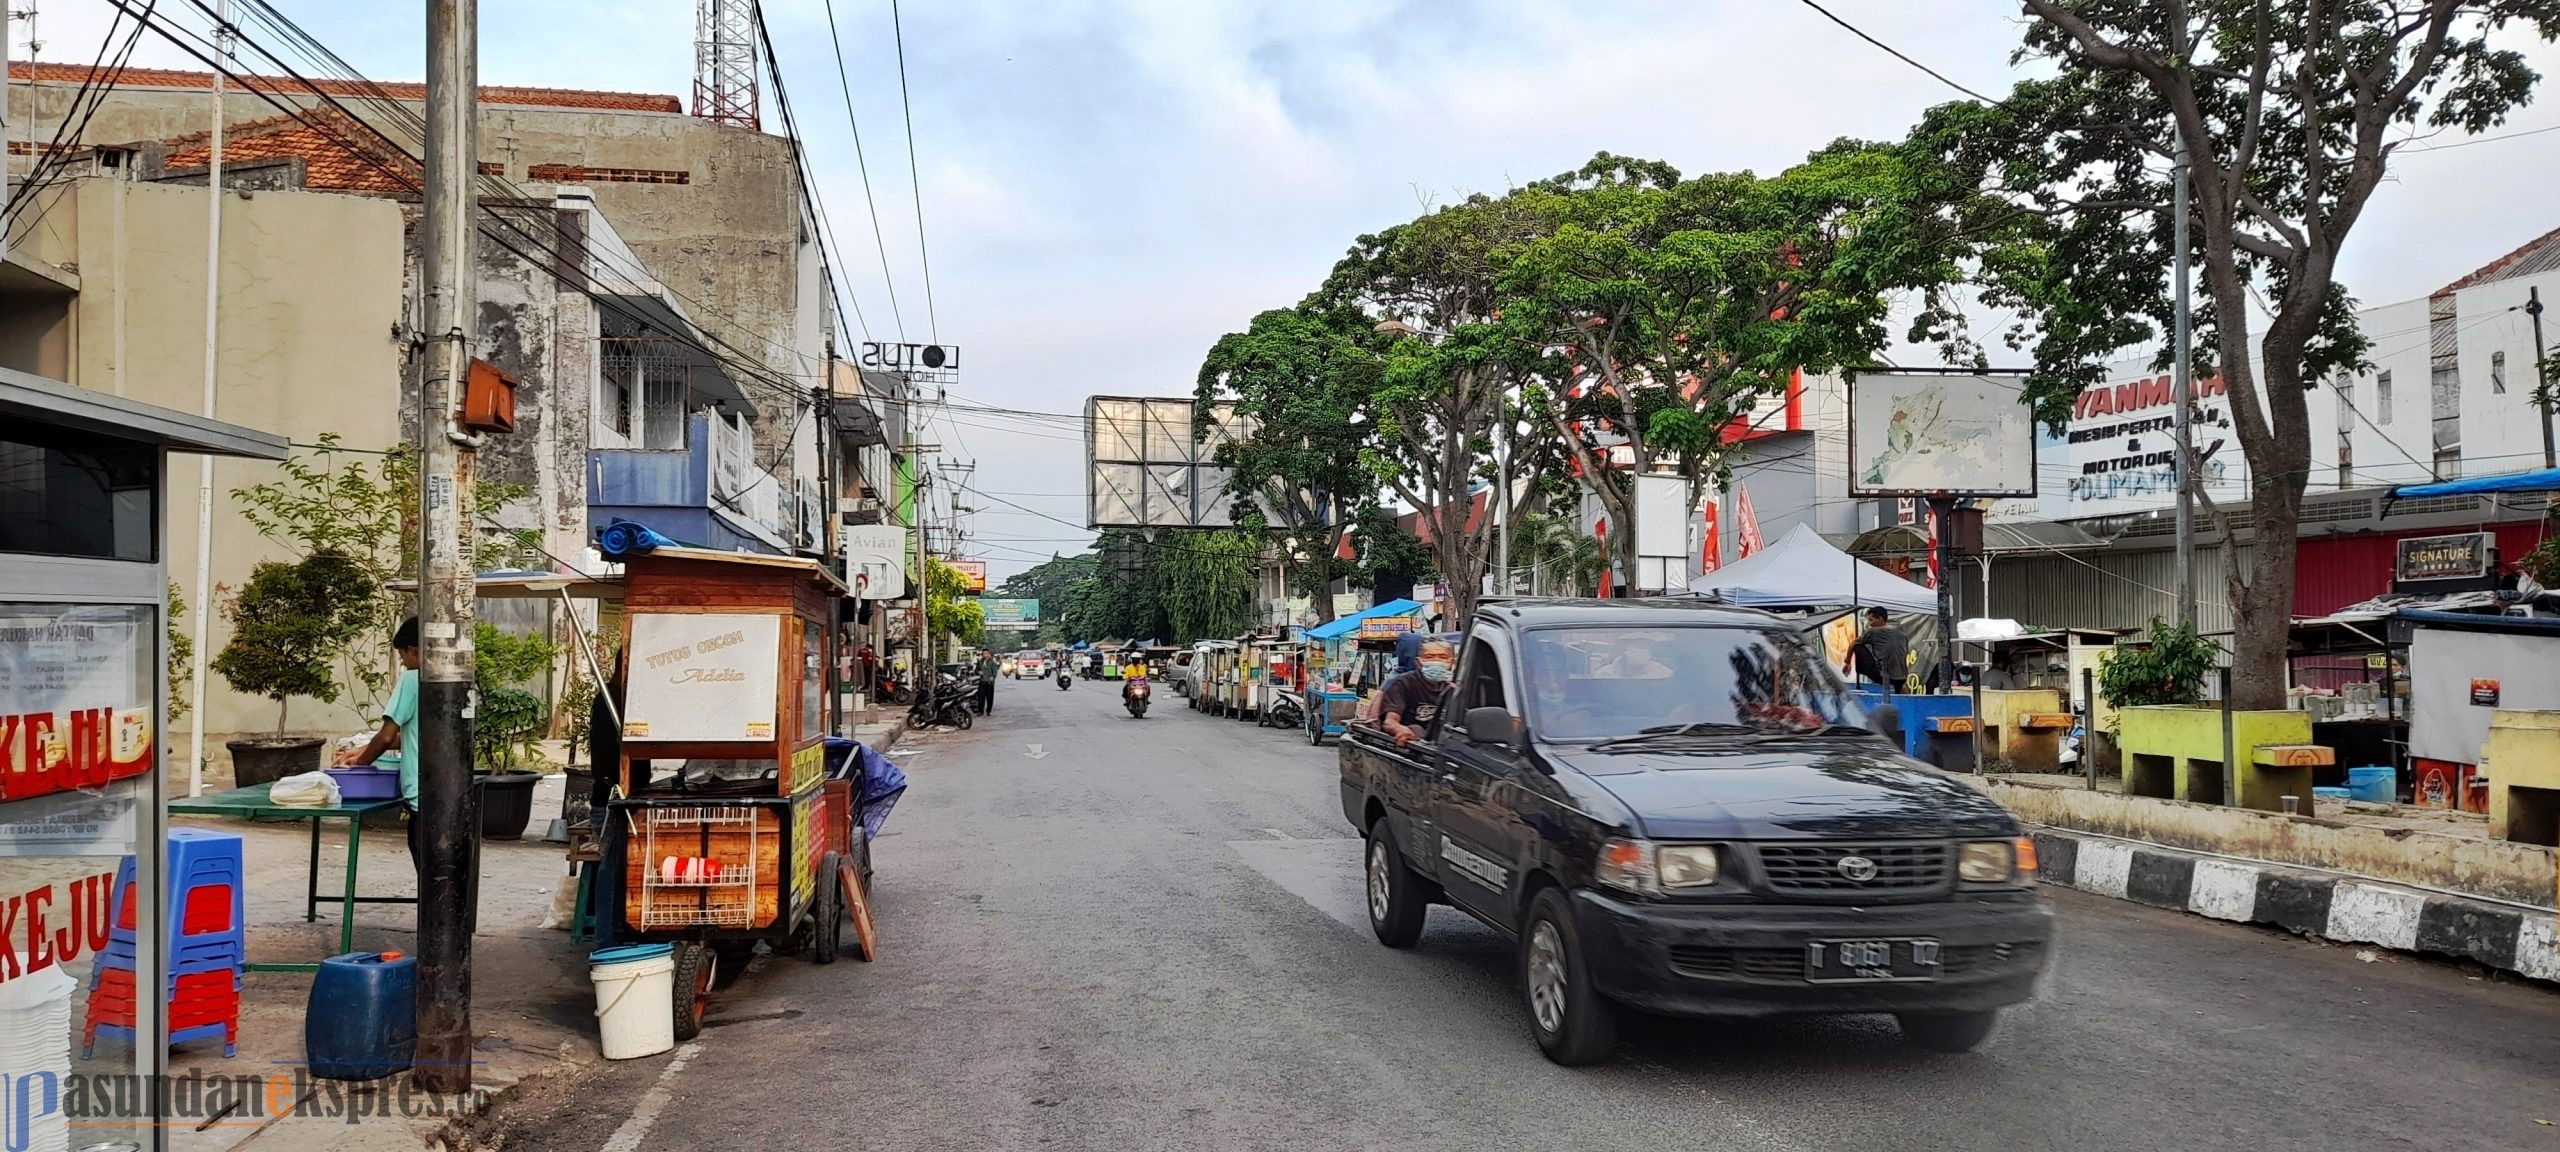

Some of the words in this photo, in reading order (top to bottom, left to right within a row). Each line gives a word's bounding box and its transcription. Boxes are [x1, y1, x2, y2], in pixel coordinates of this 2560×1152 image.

[2117, 408, 2220, 437] PERTAAN
[2127, 438, 2141, 452] &
[2082, 454, 2144, 476] MOTOR
[853, 535, 898, 549] Avian
[2409, 547, 2473, 563] SIGNATURE
[696, 630, 745, 654] ONCOM
[669, 667, 746, 685] Adelia
